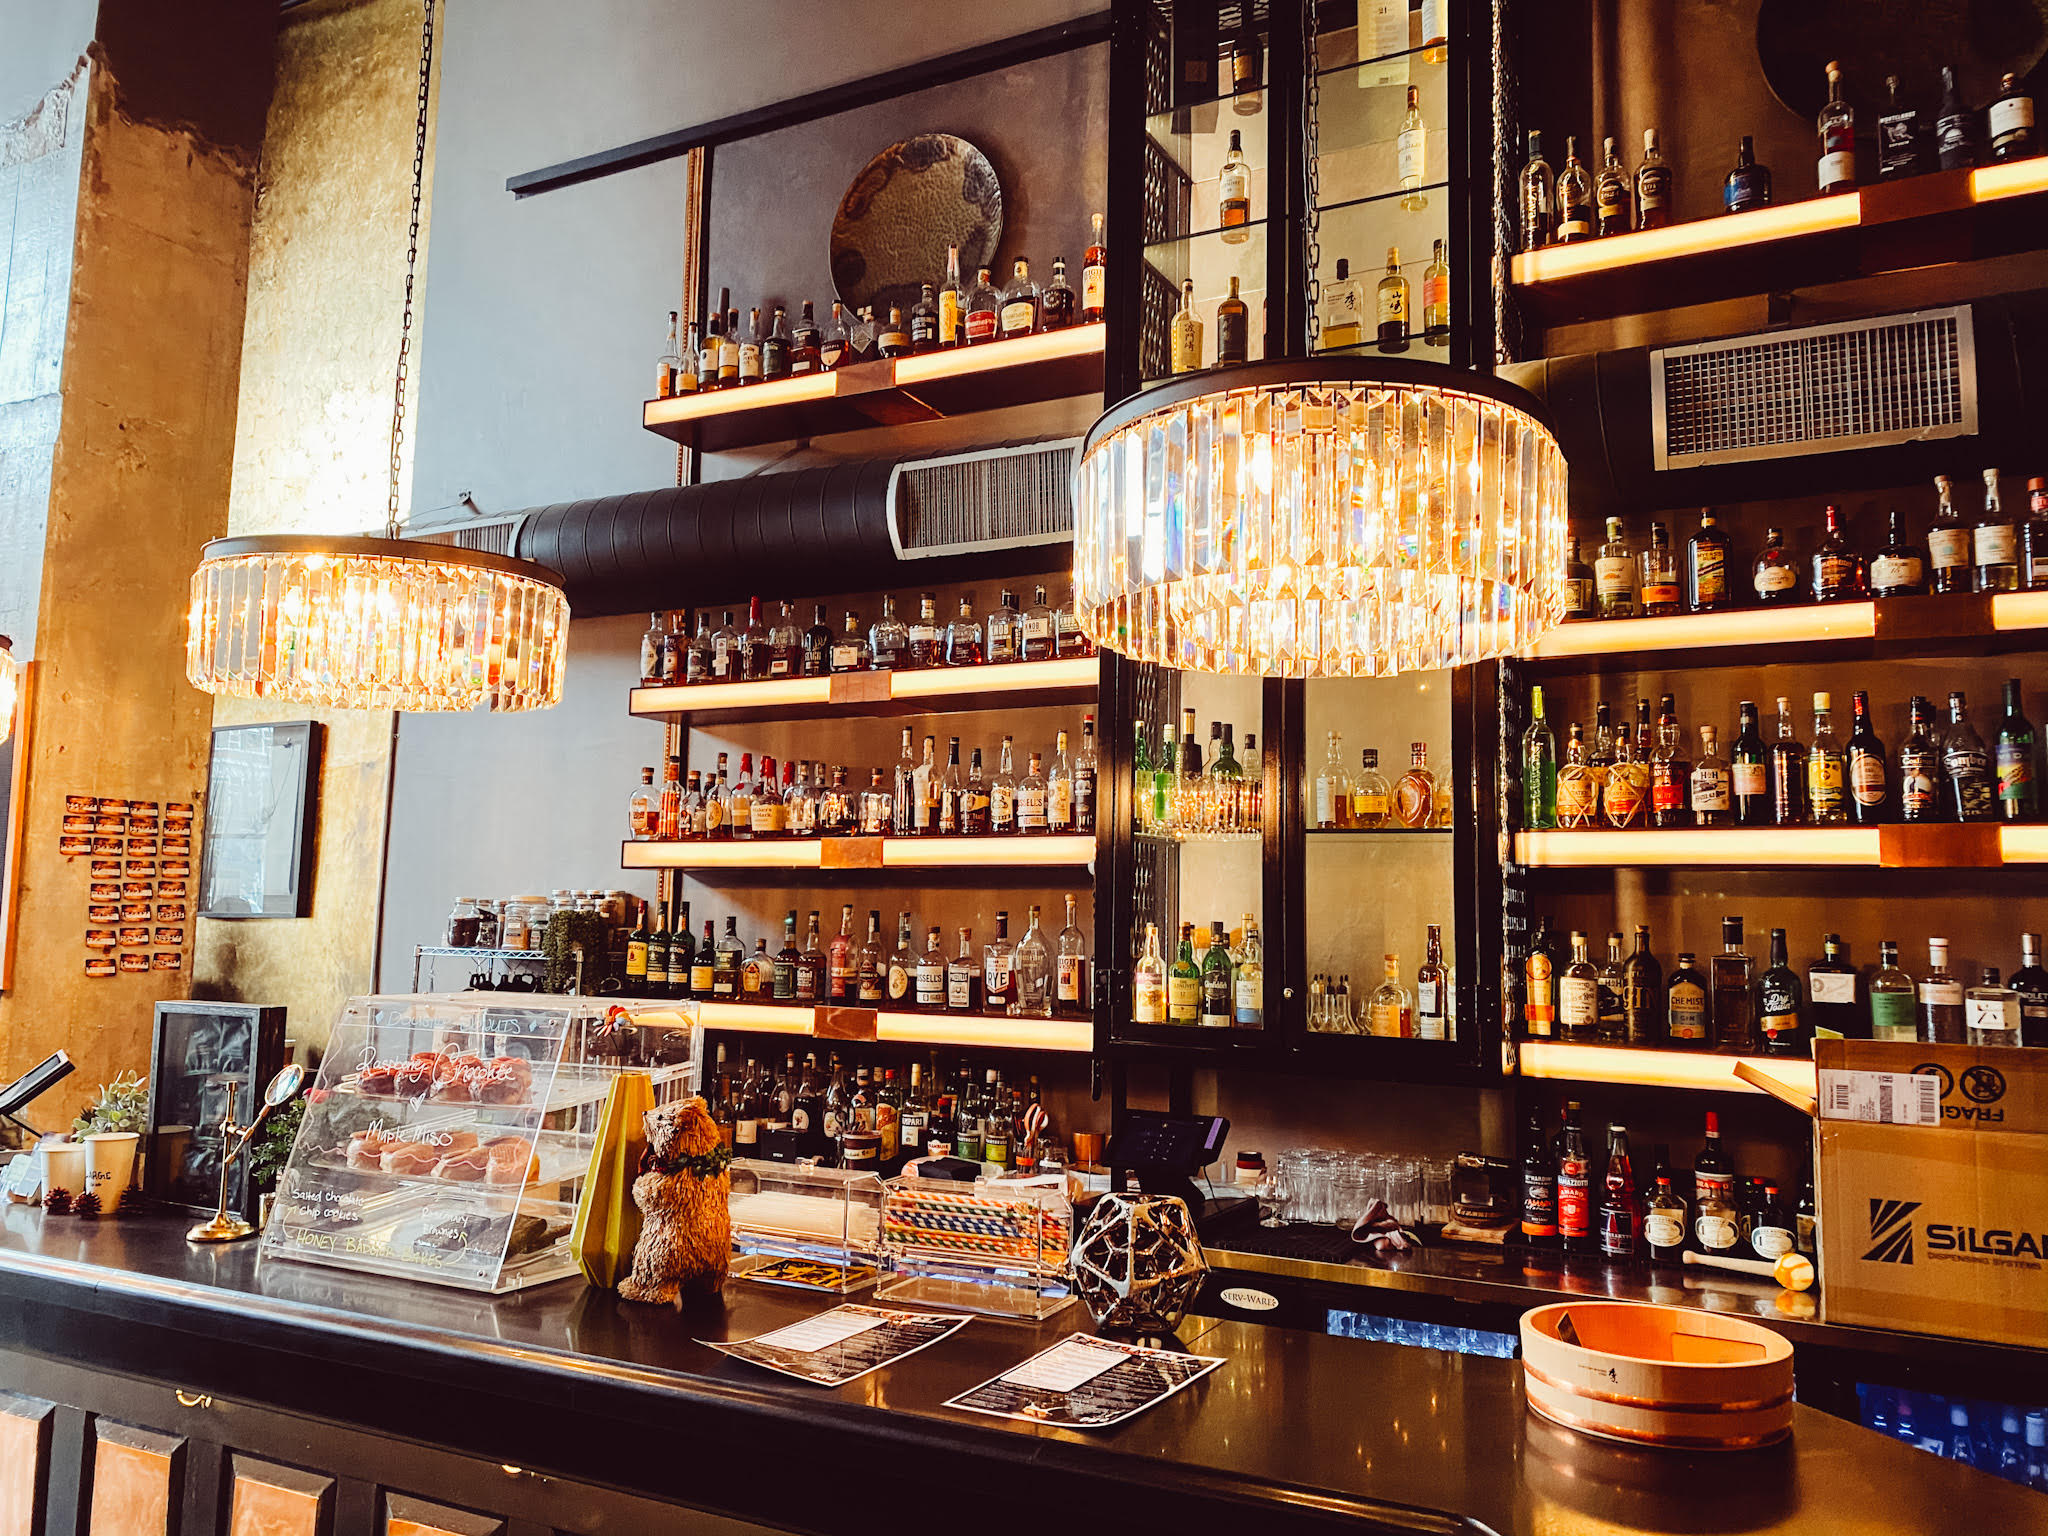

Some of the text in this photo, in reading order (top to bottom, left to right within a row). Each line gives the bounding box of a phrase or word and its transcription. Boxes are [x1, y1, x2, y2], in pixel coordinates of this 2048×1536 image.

[987, 972, 1007, 986] RYE
[1940, 1105, 2005, 1123] FRAGI
[365, 1118, 454, 1147] Maple Miso
[292, 1188, 323, 1203] Salted
[296, 1227, 337, 1253] HONEY
[1222, 1290, 1273, 1307] SERV-WARE
